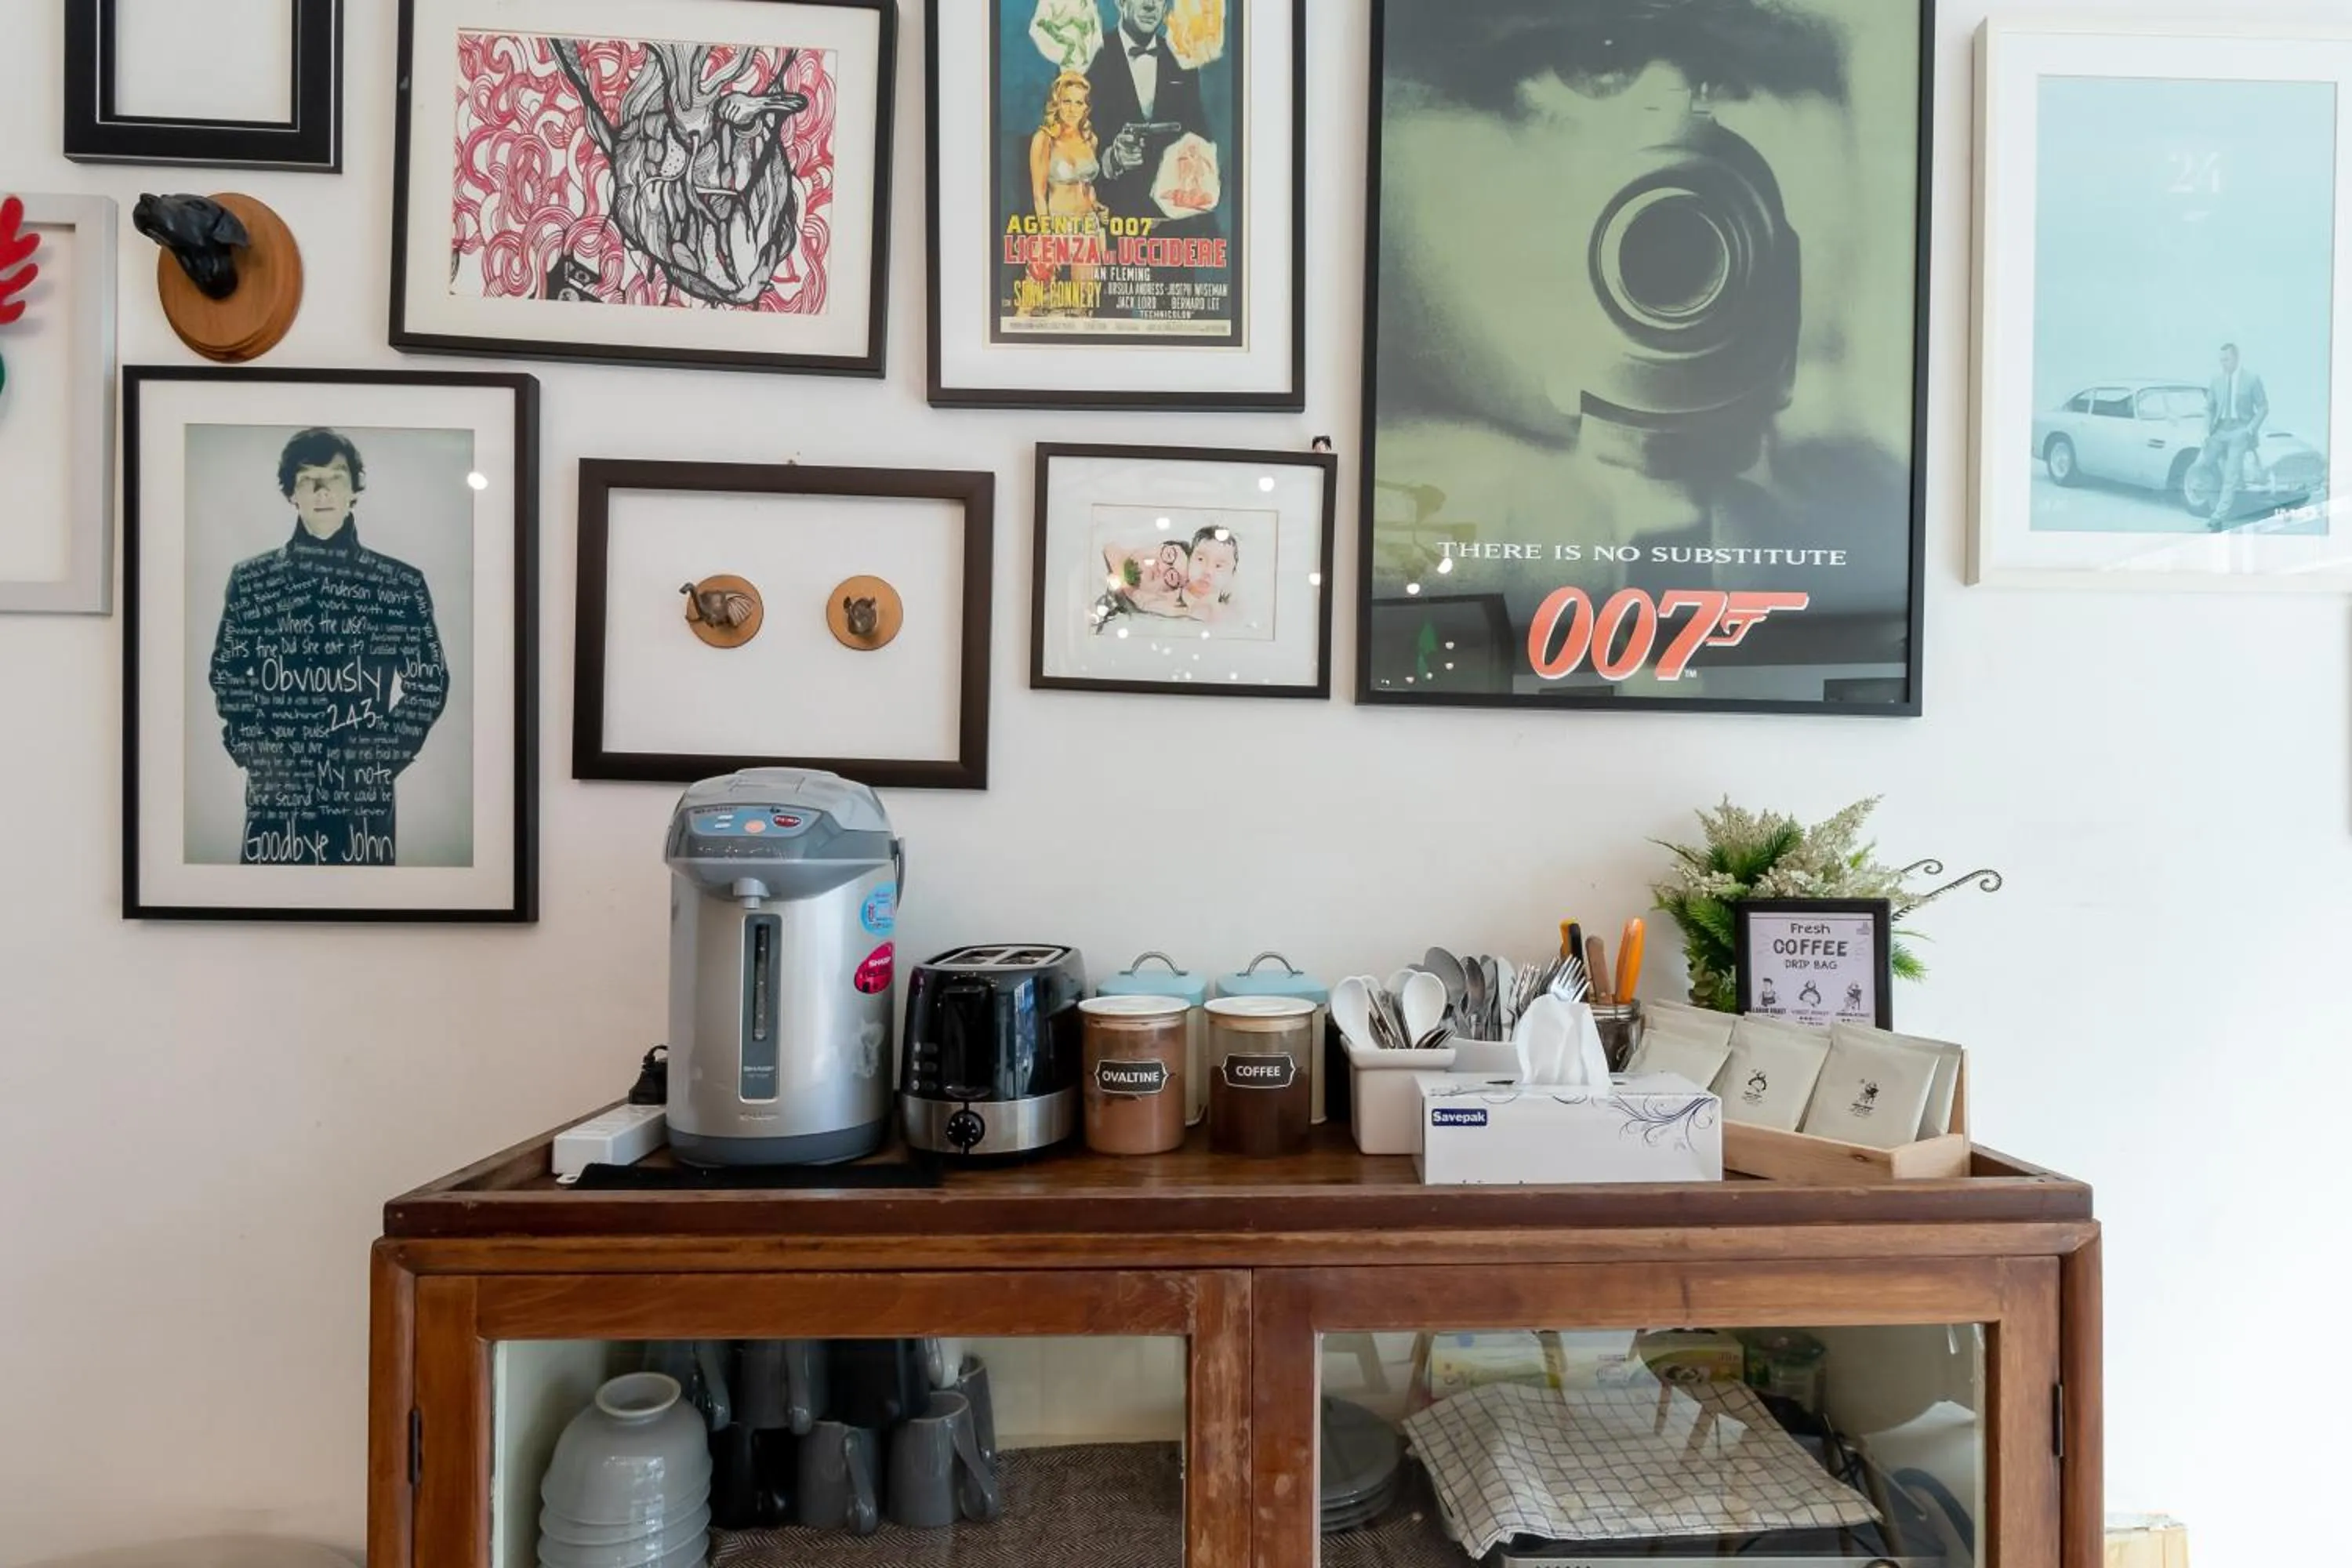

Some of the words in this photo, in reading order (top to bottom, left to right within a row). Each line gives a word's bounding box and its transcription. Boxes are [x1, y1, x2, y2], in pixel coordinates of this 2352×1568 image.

[1007, 214, 1097, 234] AGENTE
[1109, 216, 1153, 236] 007
[1004, 235, 1101, 264] LICENZA
[1117, 237, 1227, 267] UCCIDERE
[1109, 266, 1151, 281] FLEMING
[1437, 542, 1542, 559] THERE
[1555, 545, 1581, 561] IS
[1594, 546, 1641, 562] NO
[1651, 547, 1847, 565] SUBSTITUTE
[1527, 585, 1730, 681] 007
[261, 653, 381, 704] Obviously
[317, 759, 346, 791] My
[354, 761, 392, 785] note
[244, 815, 329, 866] Goodbye
[341, 815, 393, 863] John
[1790, 923, 1831, 934] Fresh
[1773, 938, 1849, 957] COFFEE
[1785, 959, 1810, 970] DRIP
[1813, 960, 1838, 970] BAG
[1102, 1069, 1160, 1083] OVALTINE
[1235, 1065, 1280, 1077] COFFEE
[1432, 1111, 1486, 1124] Savepak
